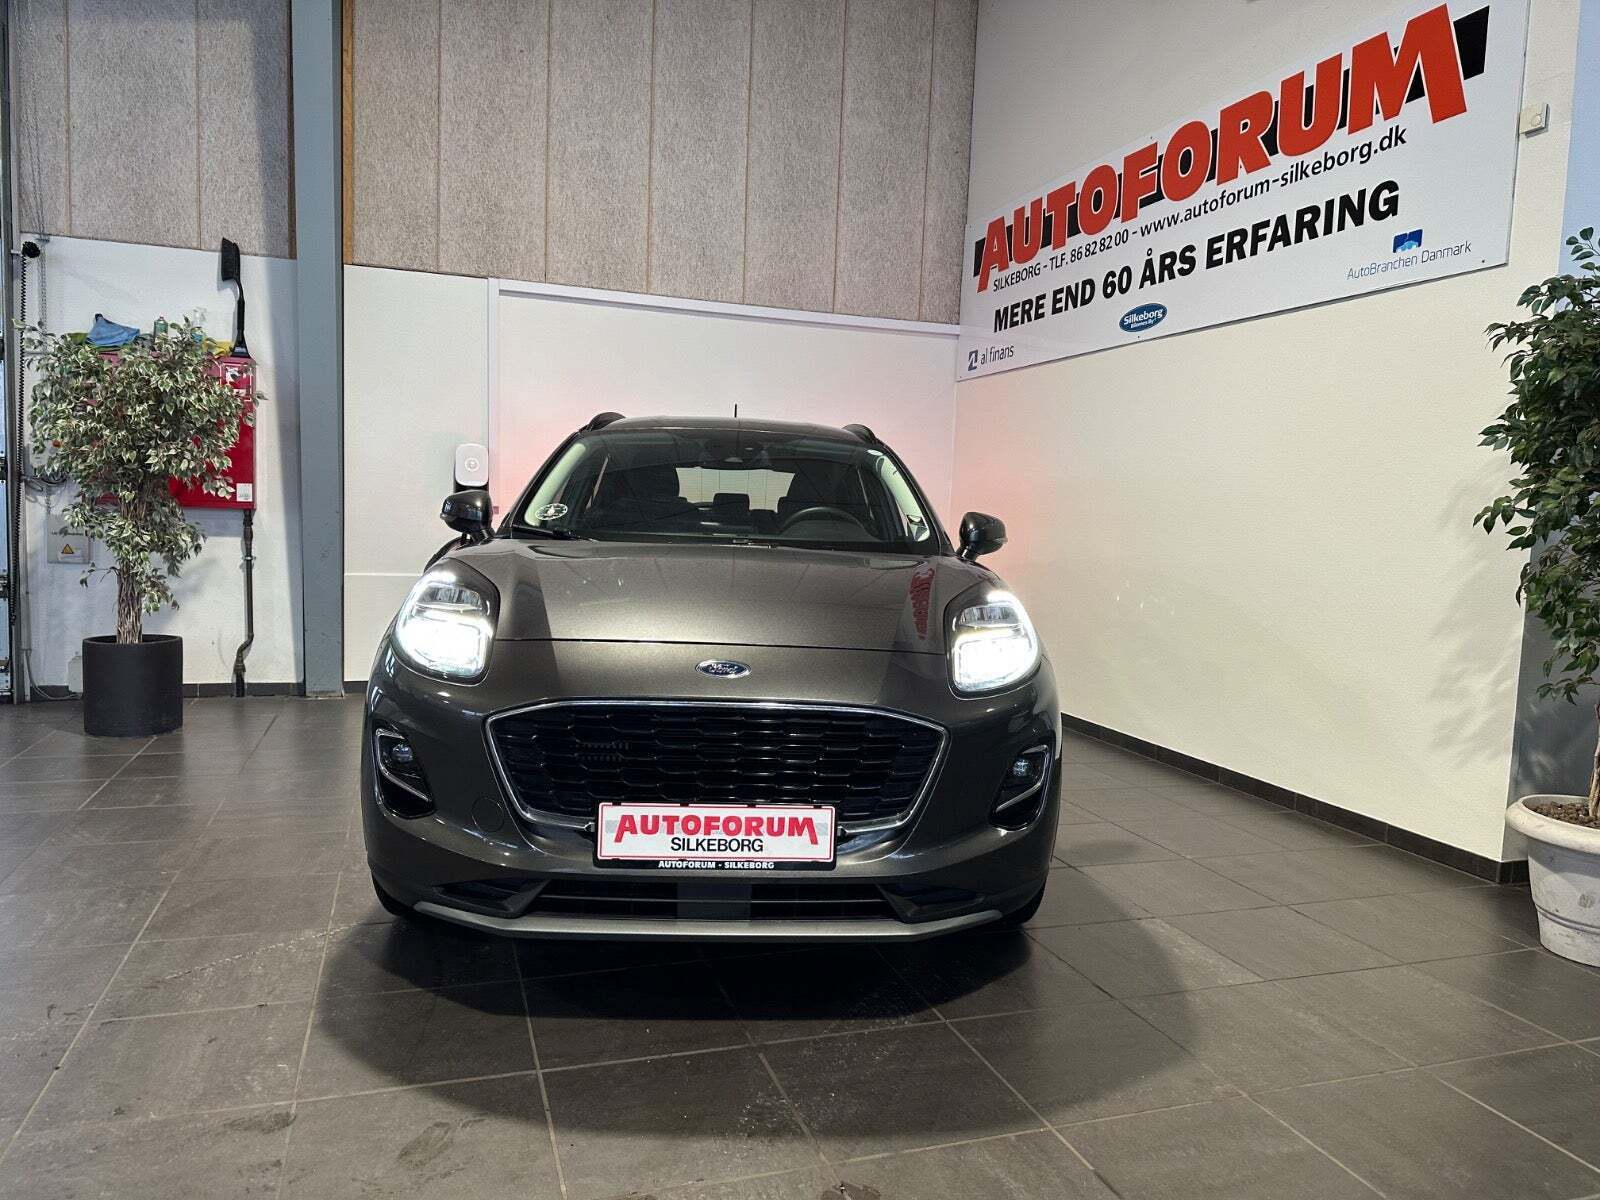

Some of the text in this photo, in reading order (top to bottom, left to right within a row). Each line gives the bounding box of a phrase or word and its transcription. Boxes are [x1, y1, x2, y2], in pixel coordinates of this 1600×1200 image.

[977, 3, 1467, 293] AUTOFORUM
[993, 263, 1041, 291] SILKEBORG
[1049, 252, 1068, 271] TLF.
[1140, 125, 1407, 236] www.autoforum-silkeborg.dk
[993, 179, 1399, 332] MERE END 60 ÅRS ERFARING
[1347, 240, 1472, 280] AutoBranchen Danmark
[1123, 309, 1164, 325] Silkeborg
[989, 345, 1014, 363] finans
[614, 814, 819, 845] AUTOFORUM
[670, 837, 764, 852] SILKEBORG
[658, 860, 716, 869] AUTOFORUM
[724, 861, 775, 870] SILKEBORG
